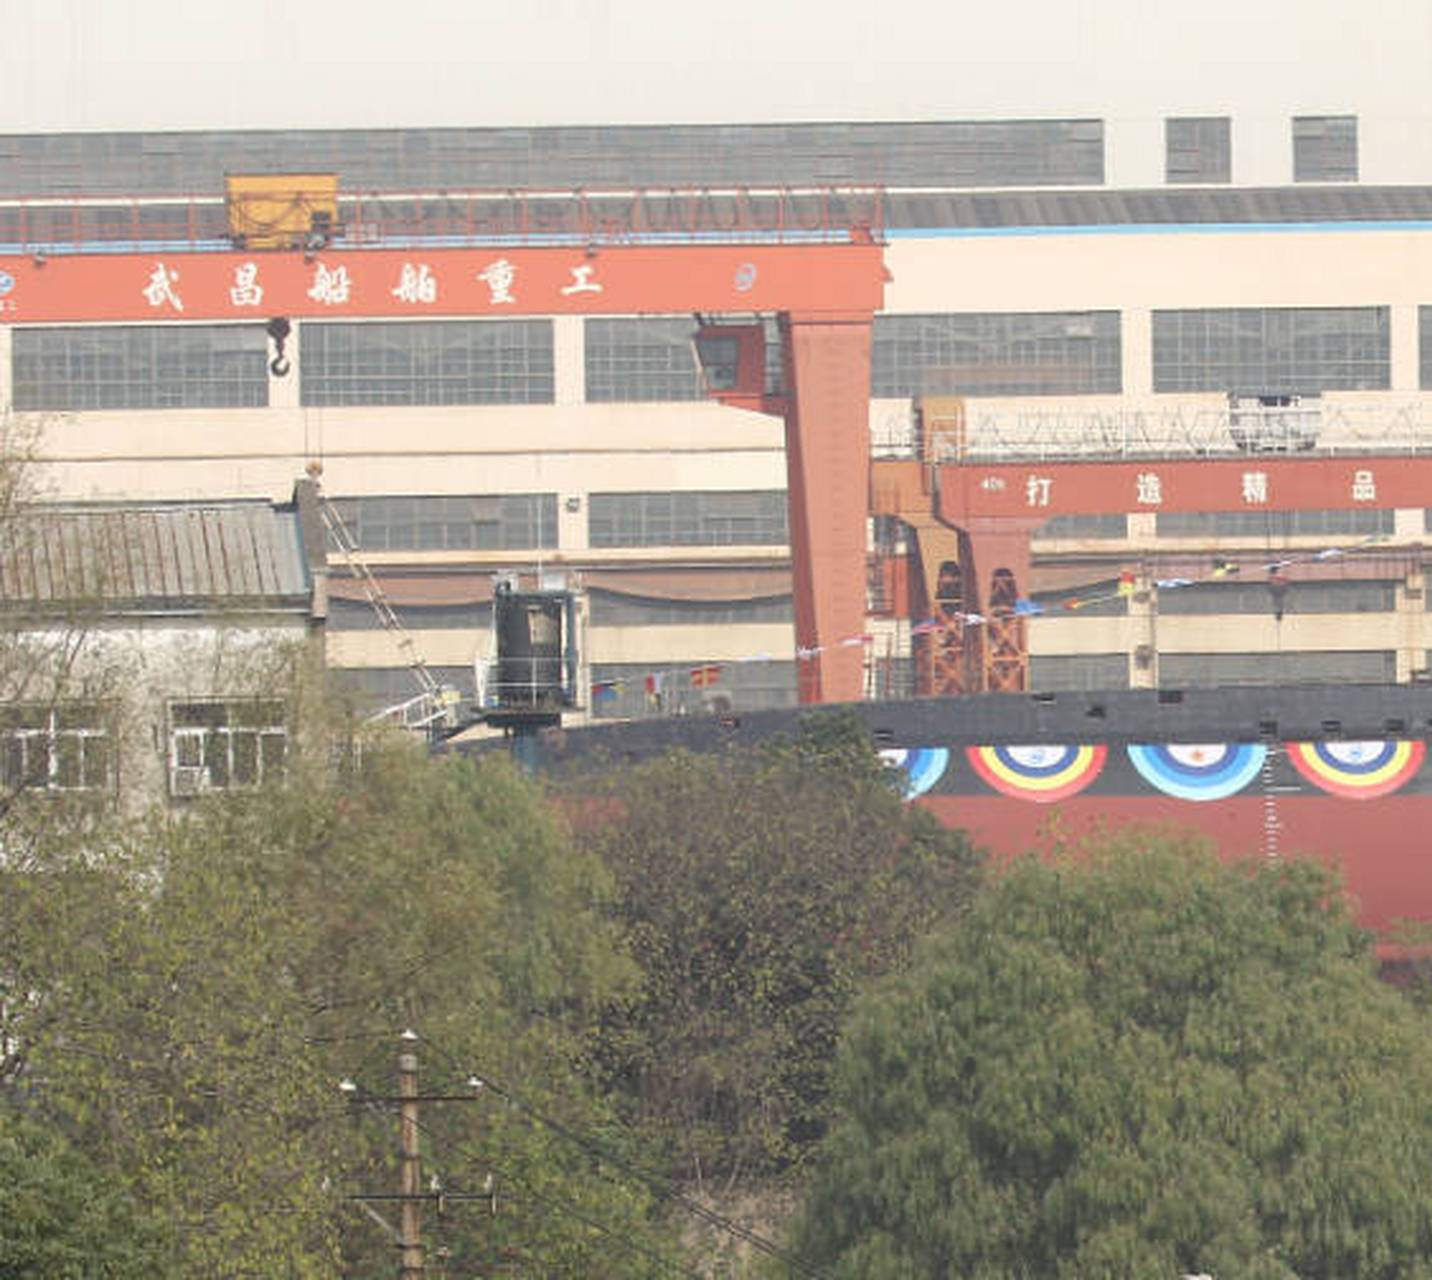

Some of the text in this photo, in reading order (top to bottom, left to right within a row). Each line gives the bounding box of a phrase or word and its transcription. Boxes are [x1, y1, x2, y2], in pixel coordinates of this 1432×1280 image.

[142, 259, 603, 312] 武昌船舶重工
